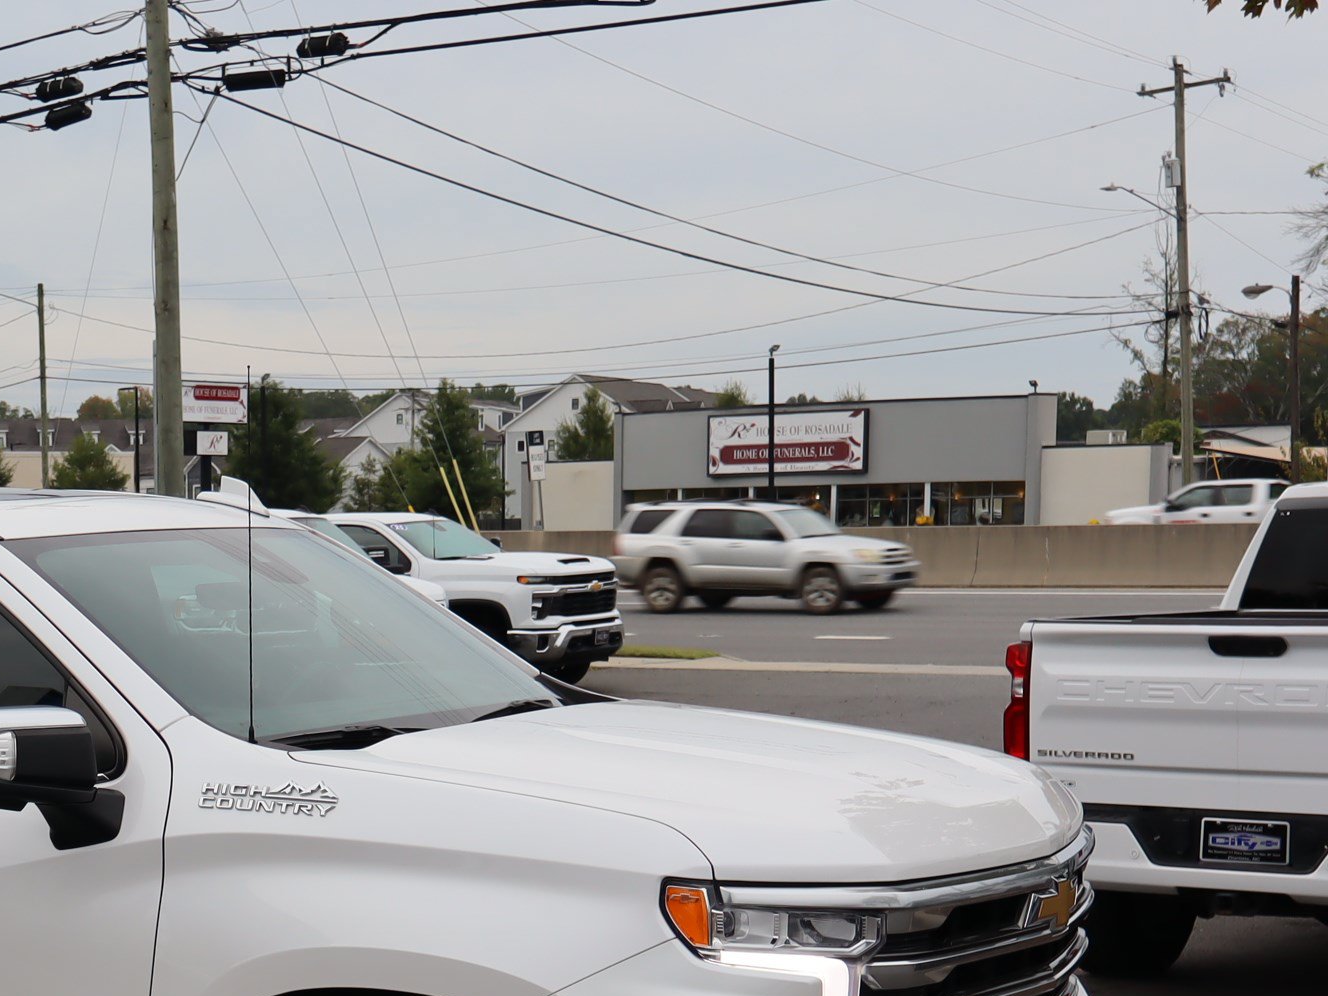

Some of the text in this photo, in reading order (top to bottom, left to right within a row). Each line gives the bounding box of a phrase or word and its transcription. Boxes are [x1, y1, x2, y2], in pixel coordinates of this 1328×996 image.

[756, 426, 786, 437] HOSE
[789, 425, 802, 436] OF
[804, 423, 852, 435] ROSADALE
[733, 448, 758, 460] HOME
[773, 446, 818, 458] FUNERALS,
[819, 446, 835, 457] LLC
[1056, 679, 1328, 707] CHEVRO
[1037, 749, 1135, 761] SILVERADO
[201, 782, 268, 797] HIGH
[198, 796, 337, 817] COUNTRY
